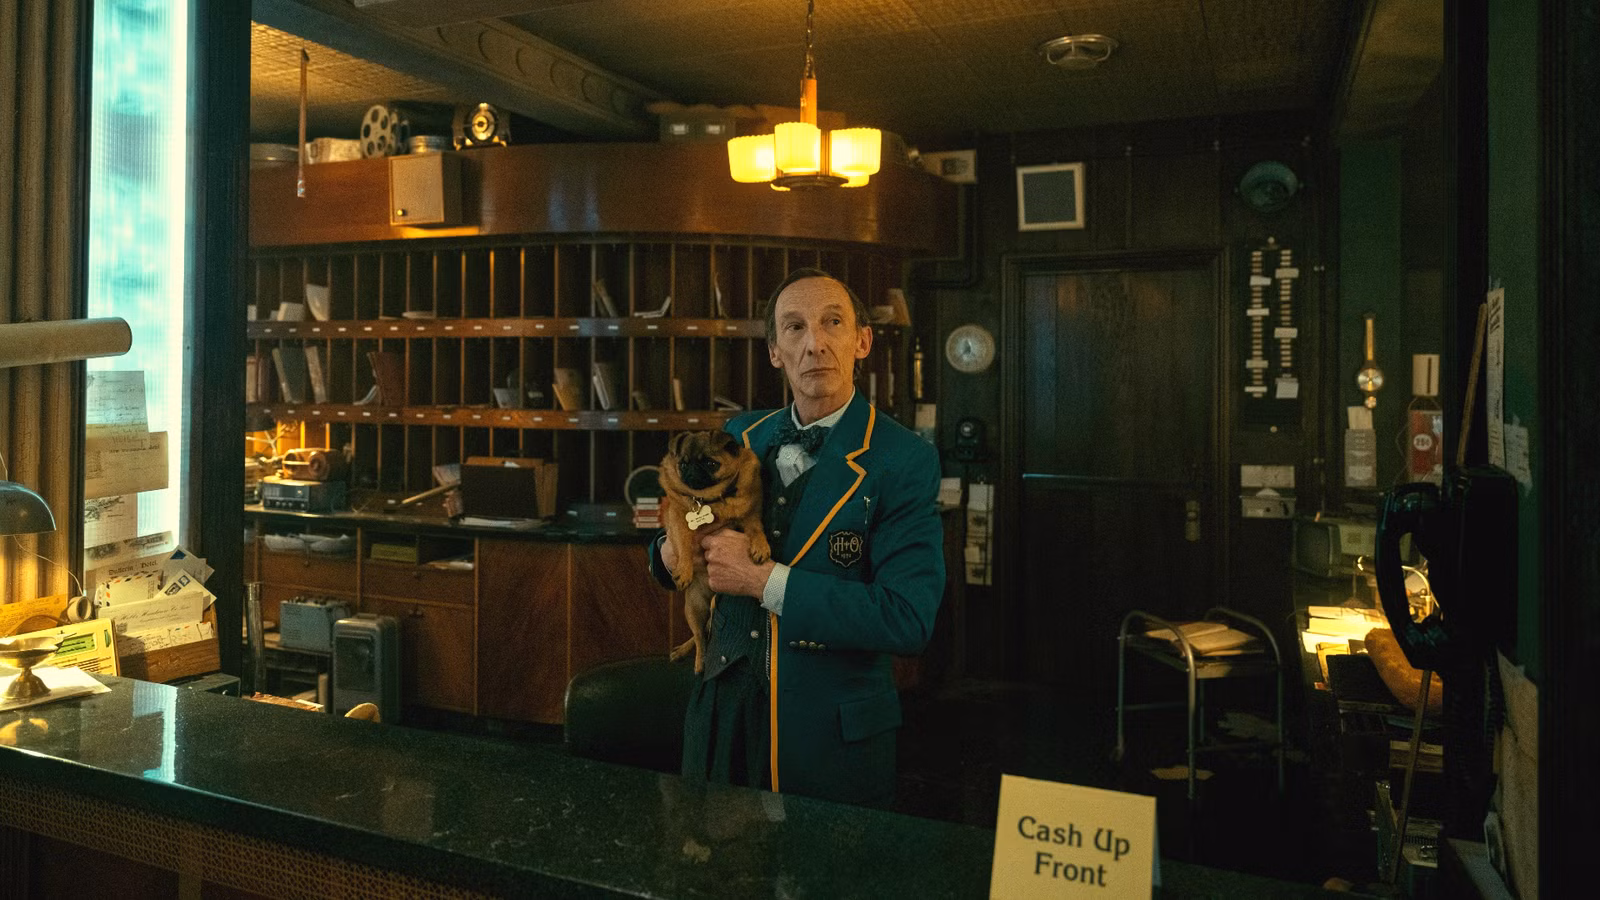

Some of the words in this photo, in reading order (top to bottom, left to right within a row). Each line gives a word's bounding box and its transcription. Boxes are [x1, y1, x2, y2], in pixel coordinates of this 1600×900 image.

[1017, 815, 1082, 848] Cash
[1093, 827, 1130, 861] Up
[1034, 851, 1107, 887] Front
